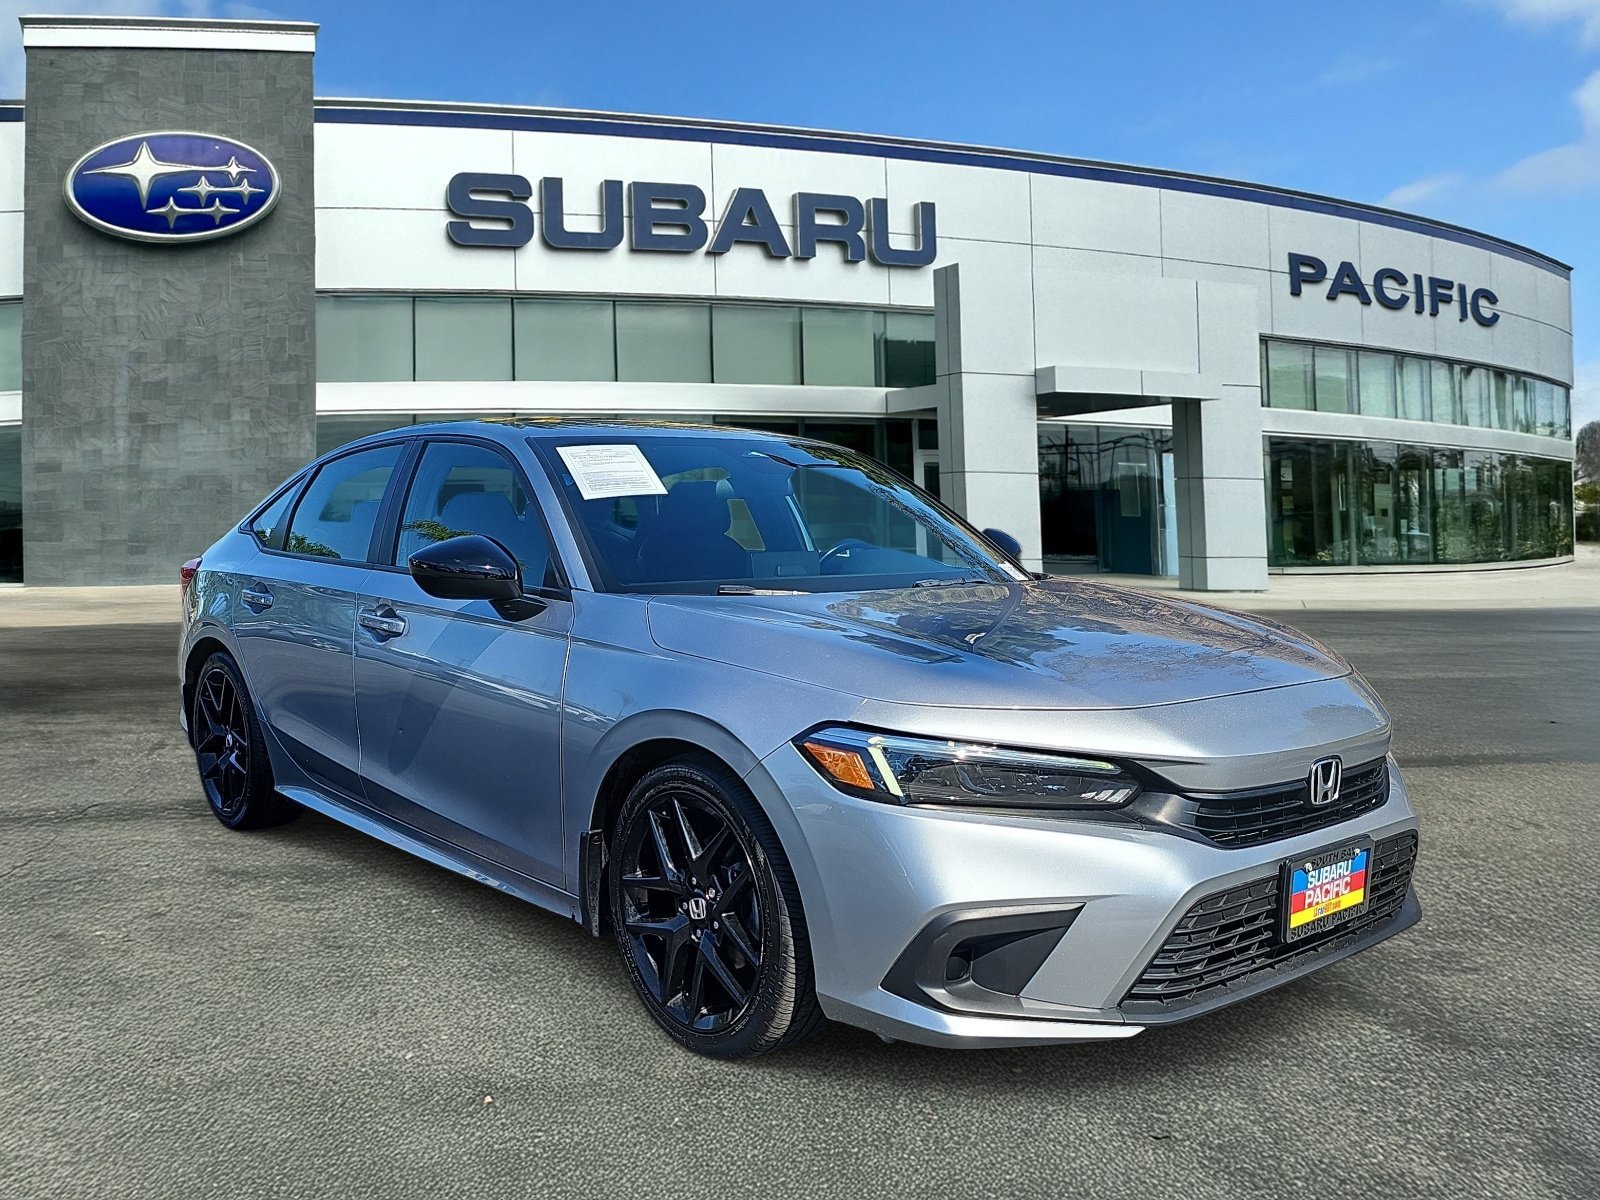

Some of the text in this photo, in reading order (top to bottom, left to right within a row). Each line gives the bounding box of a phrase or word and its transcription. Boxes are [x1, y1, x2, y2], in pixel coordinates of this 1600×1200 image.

[446, 172, 937, 268] SUBARU
[1288, 252, 1500, 327] PACIFIC
[1307, 859, 1352, 888] SUBARU
[1311, 851, 1339, 867] SOUTH
[1304, 876, 1351, 909] PACIFIC
[1290, 917, 1329, 939] SUBARU
[1331, 904, 1366, 923] PACIFIC
